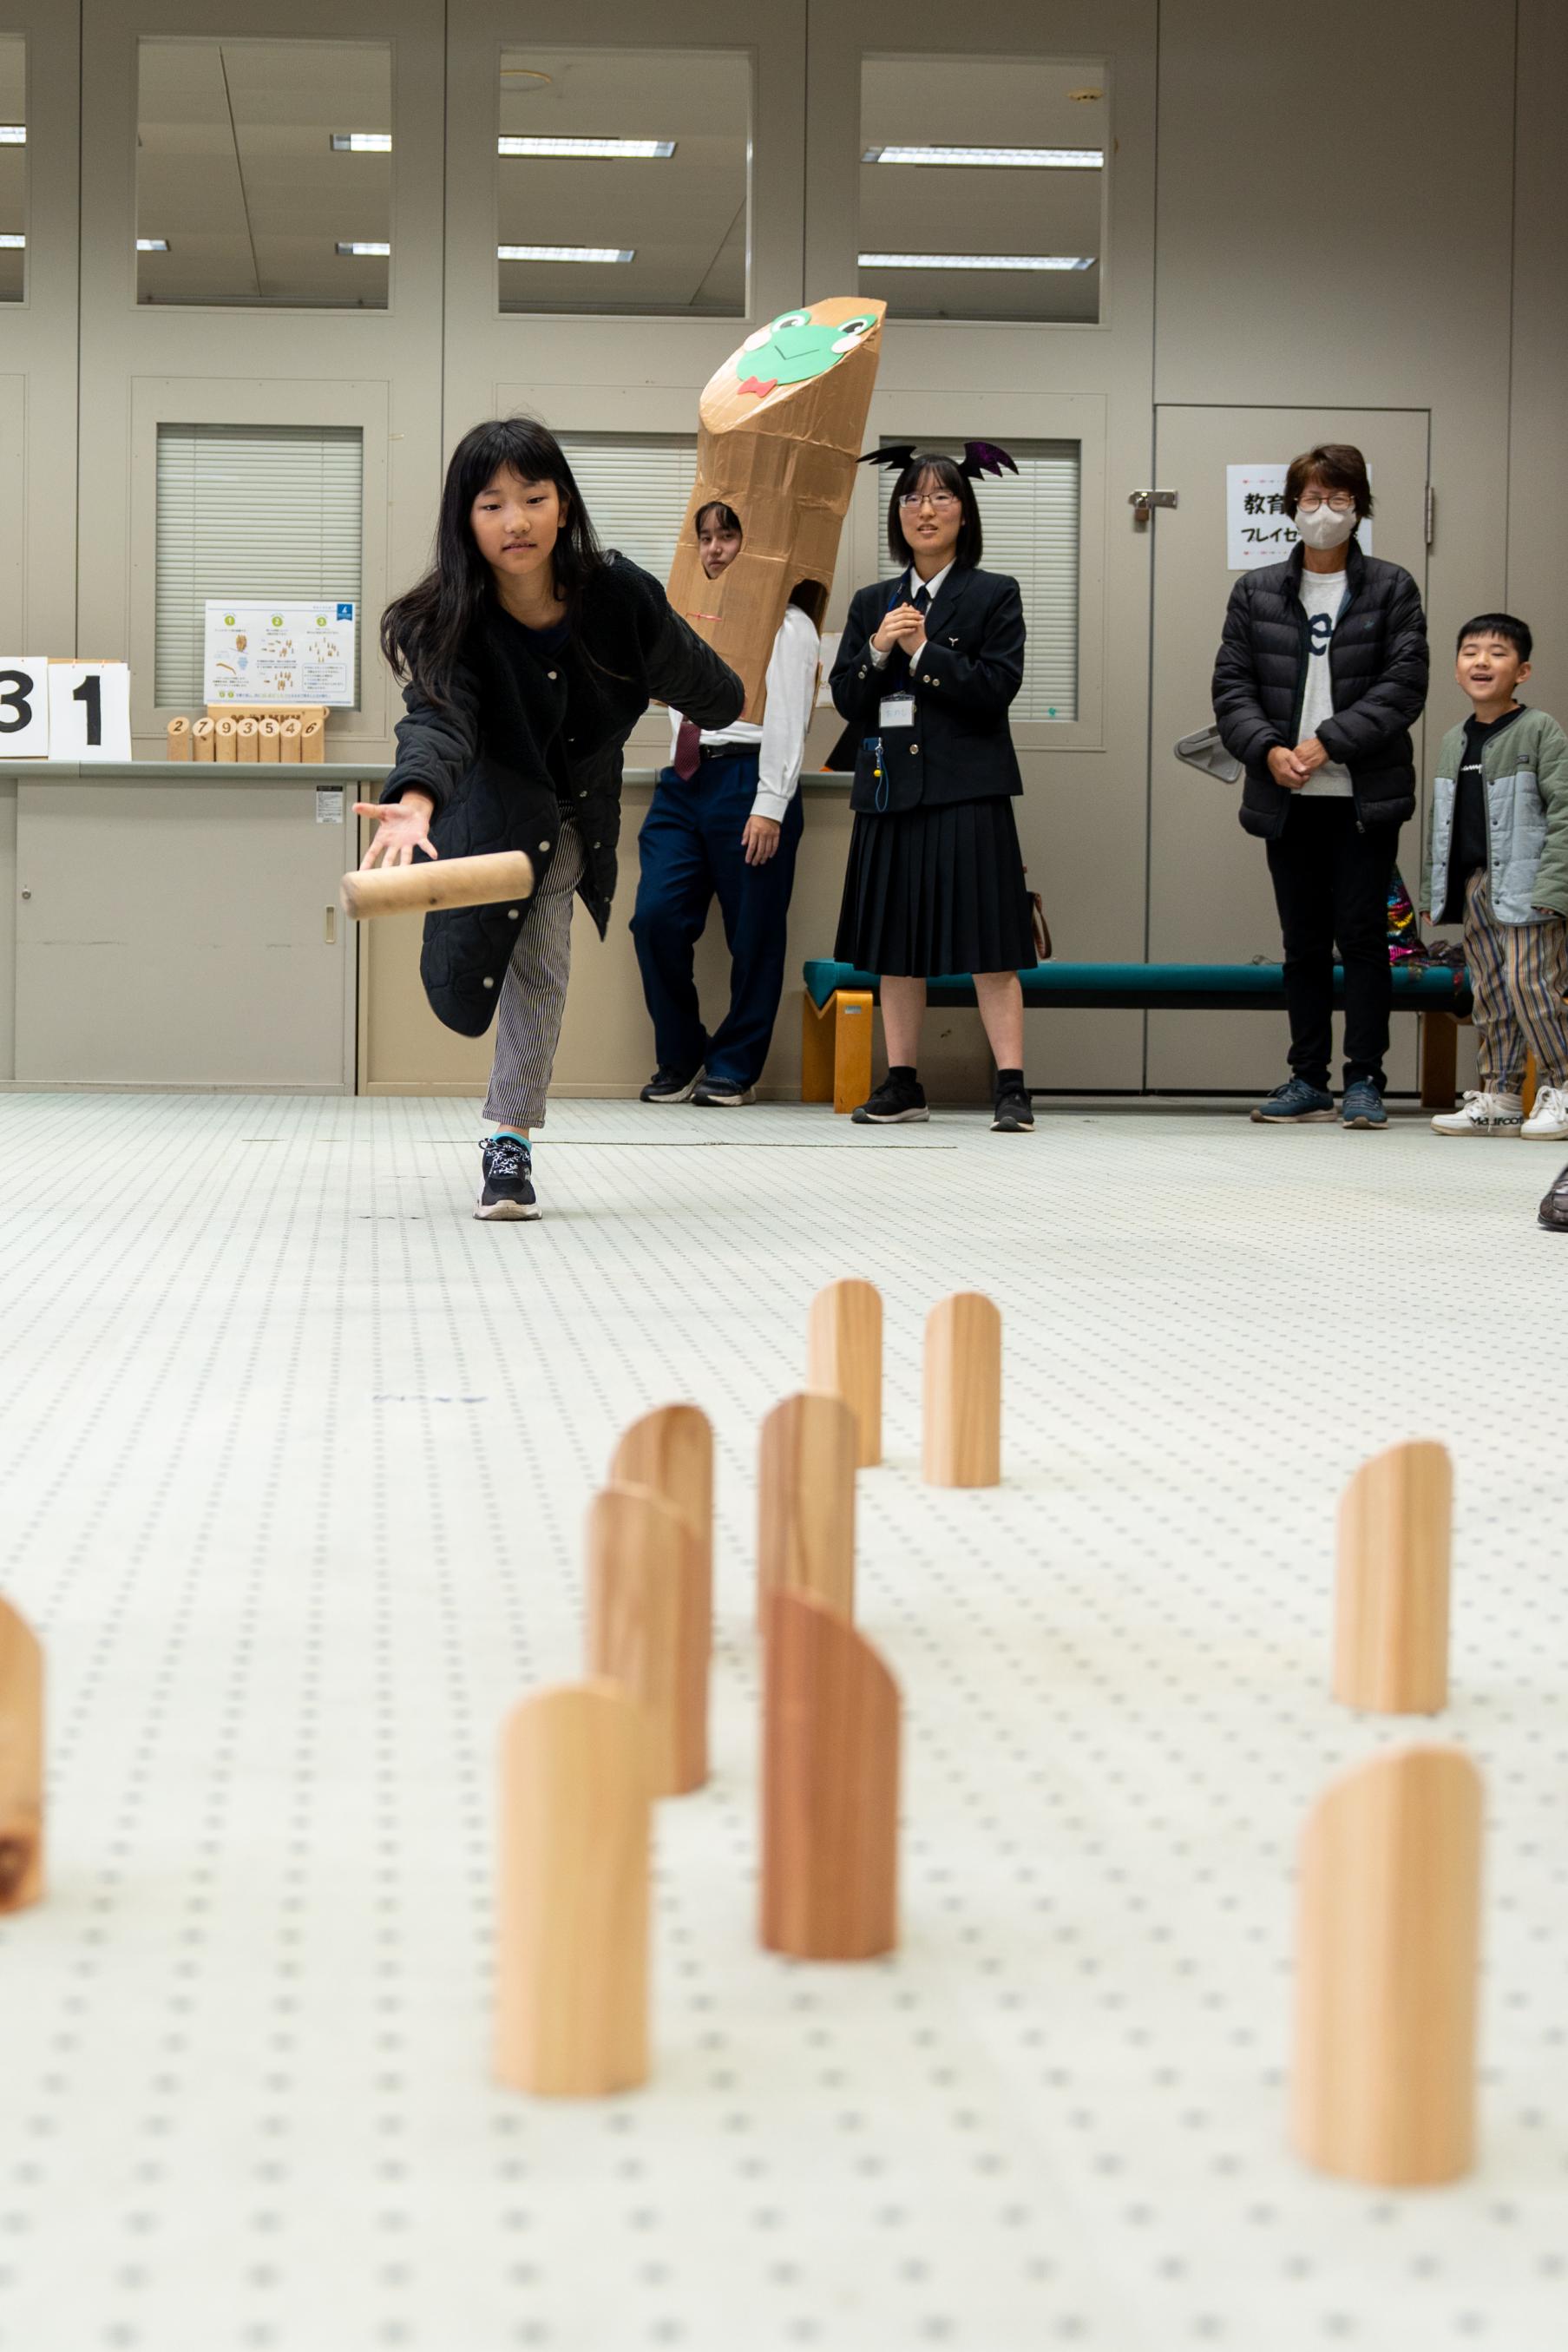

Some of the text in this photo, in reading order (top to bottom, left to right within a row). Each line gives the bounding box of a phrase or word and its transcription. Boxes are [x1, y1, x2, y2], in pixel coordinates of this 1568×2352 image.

[1241, 528, 1299, 542] プレイセ
[73, 675, 102, 746] 1
[174, 720, 183, 732] 2
[198, 721, 207, 733] 7
[222, 722, 231, 733] 9
[243, 722, 253, 733] 3
[266, 723, 273, 733] 5
[285, 723, 294, 733] 4
[305, 722, 317, 733] 6
